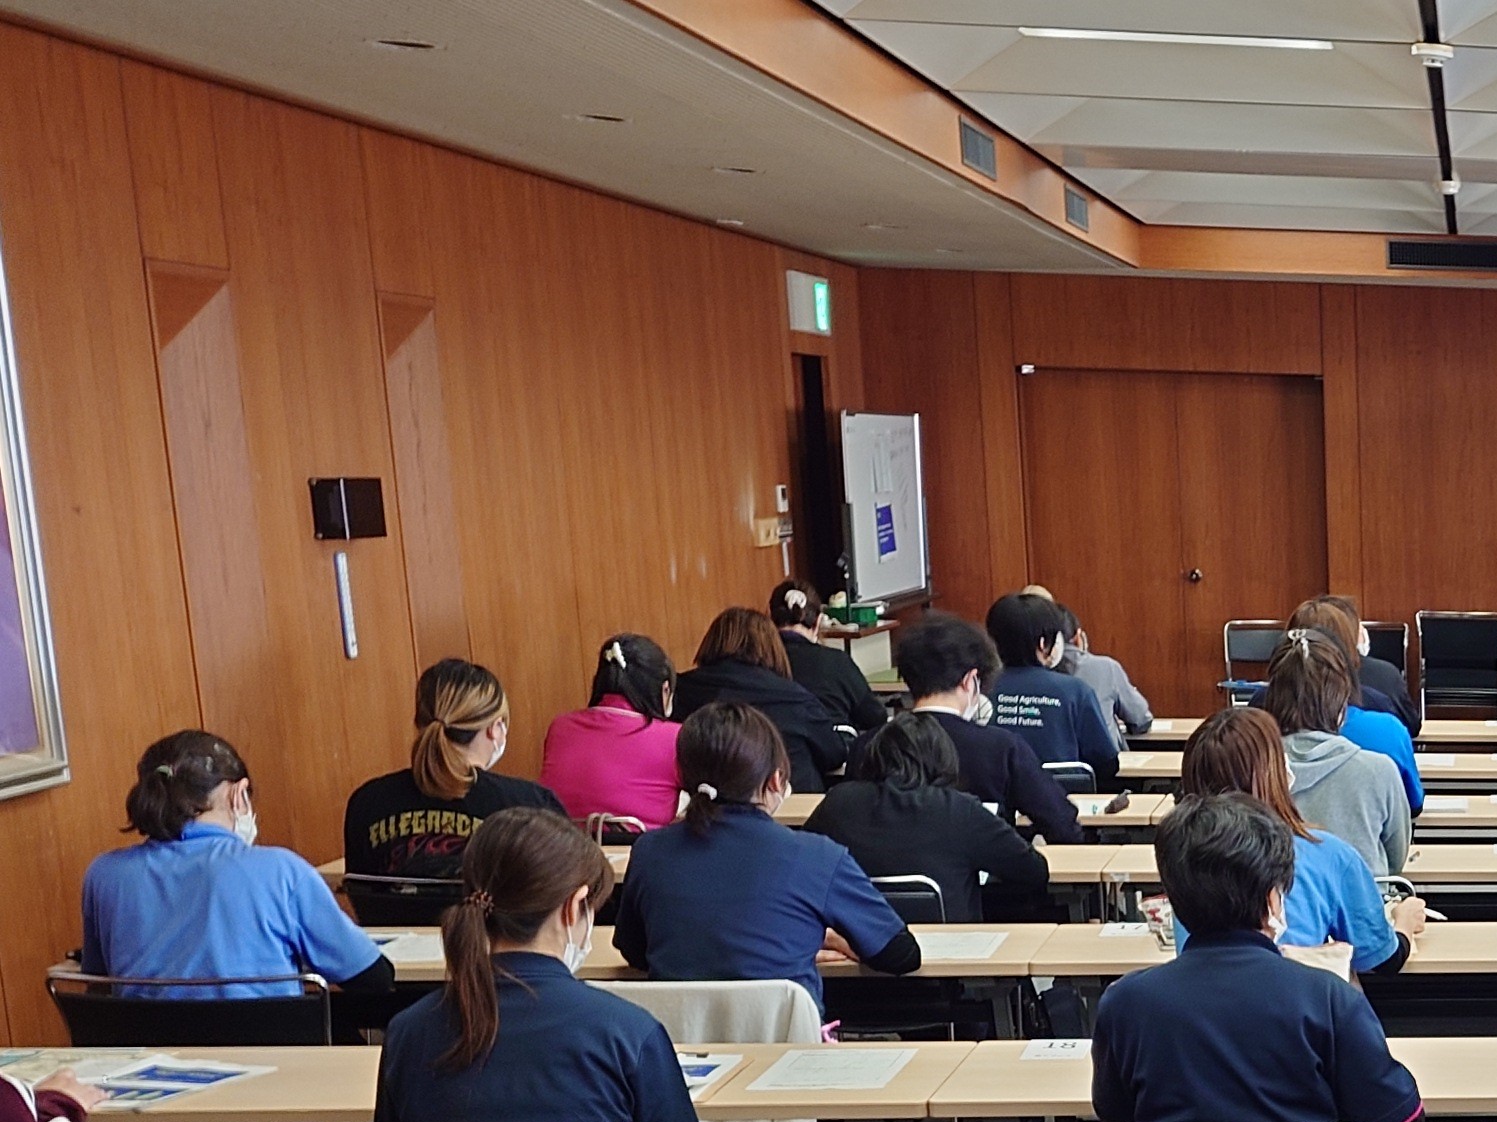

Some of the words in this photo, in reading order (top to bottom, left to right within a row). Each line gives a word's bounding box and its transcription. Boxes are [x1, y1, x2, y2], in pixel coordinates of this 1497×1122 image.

[997, 694, 1018, 704] Good
[1019, 695, 1062, 708] Agriculture,
[997, 705, 1018, 714] Good
[997, 716, 1018, 725] Good
